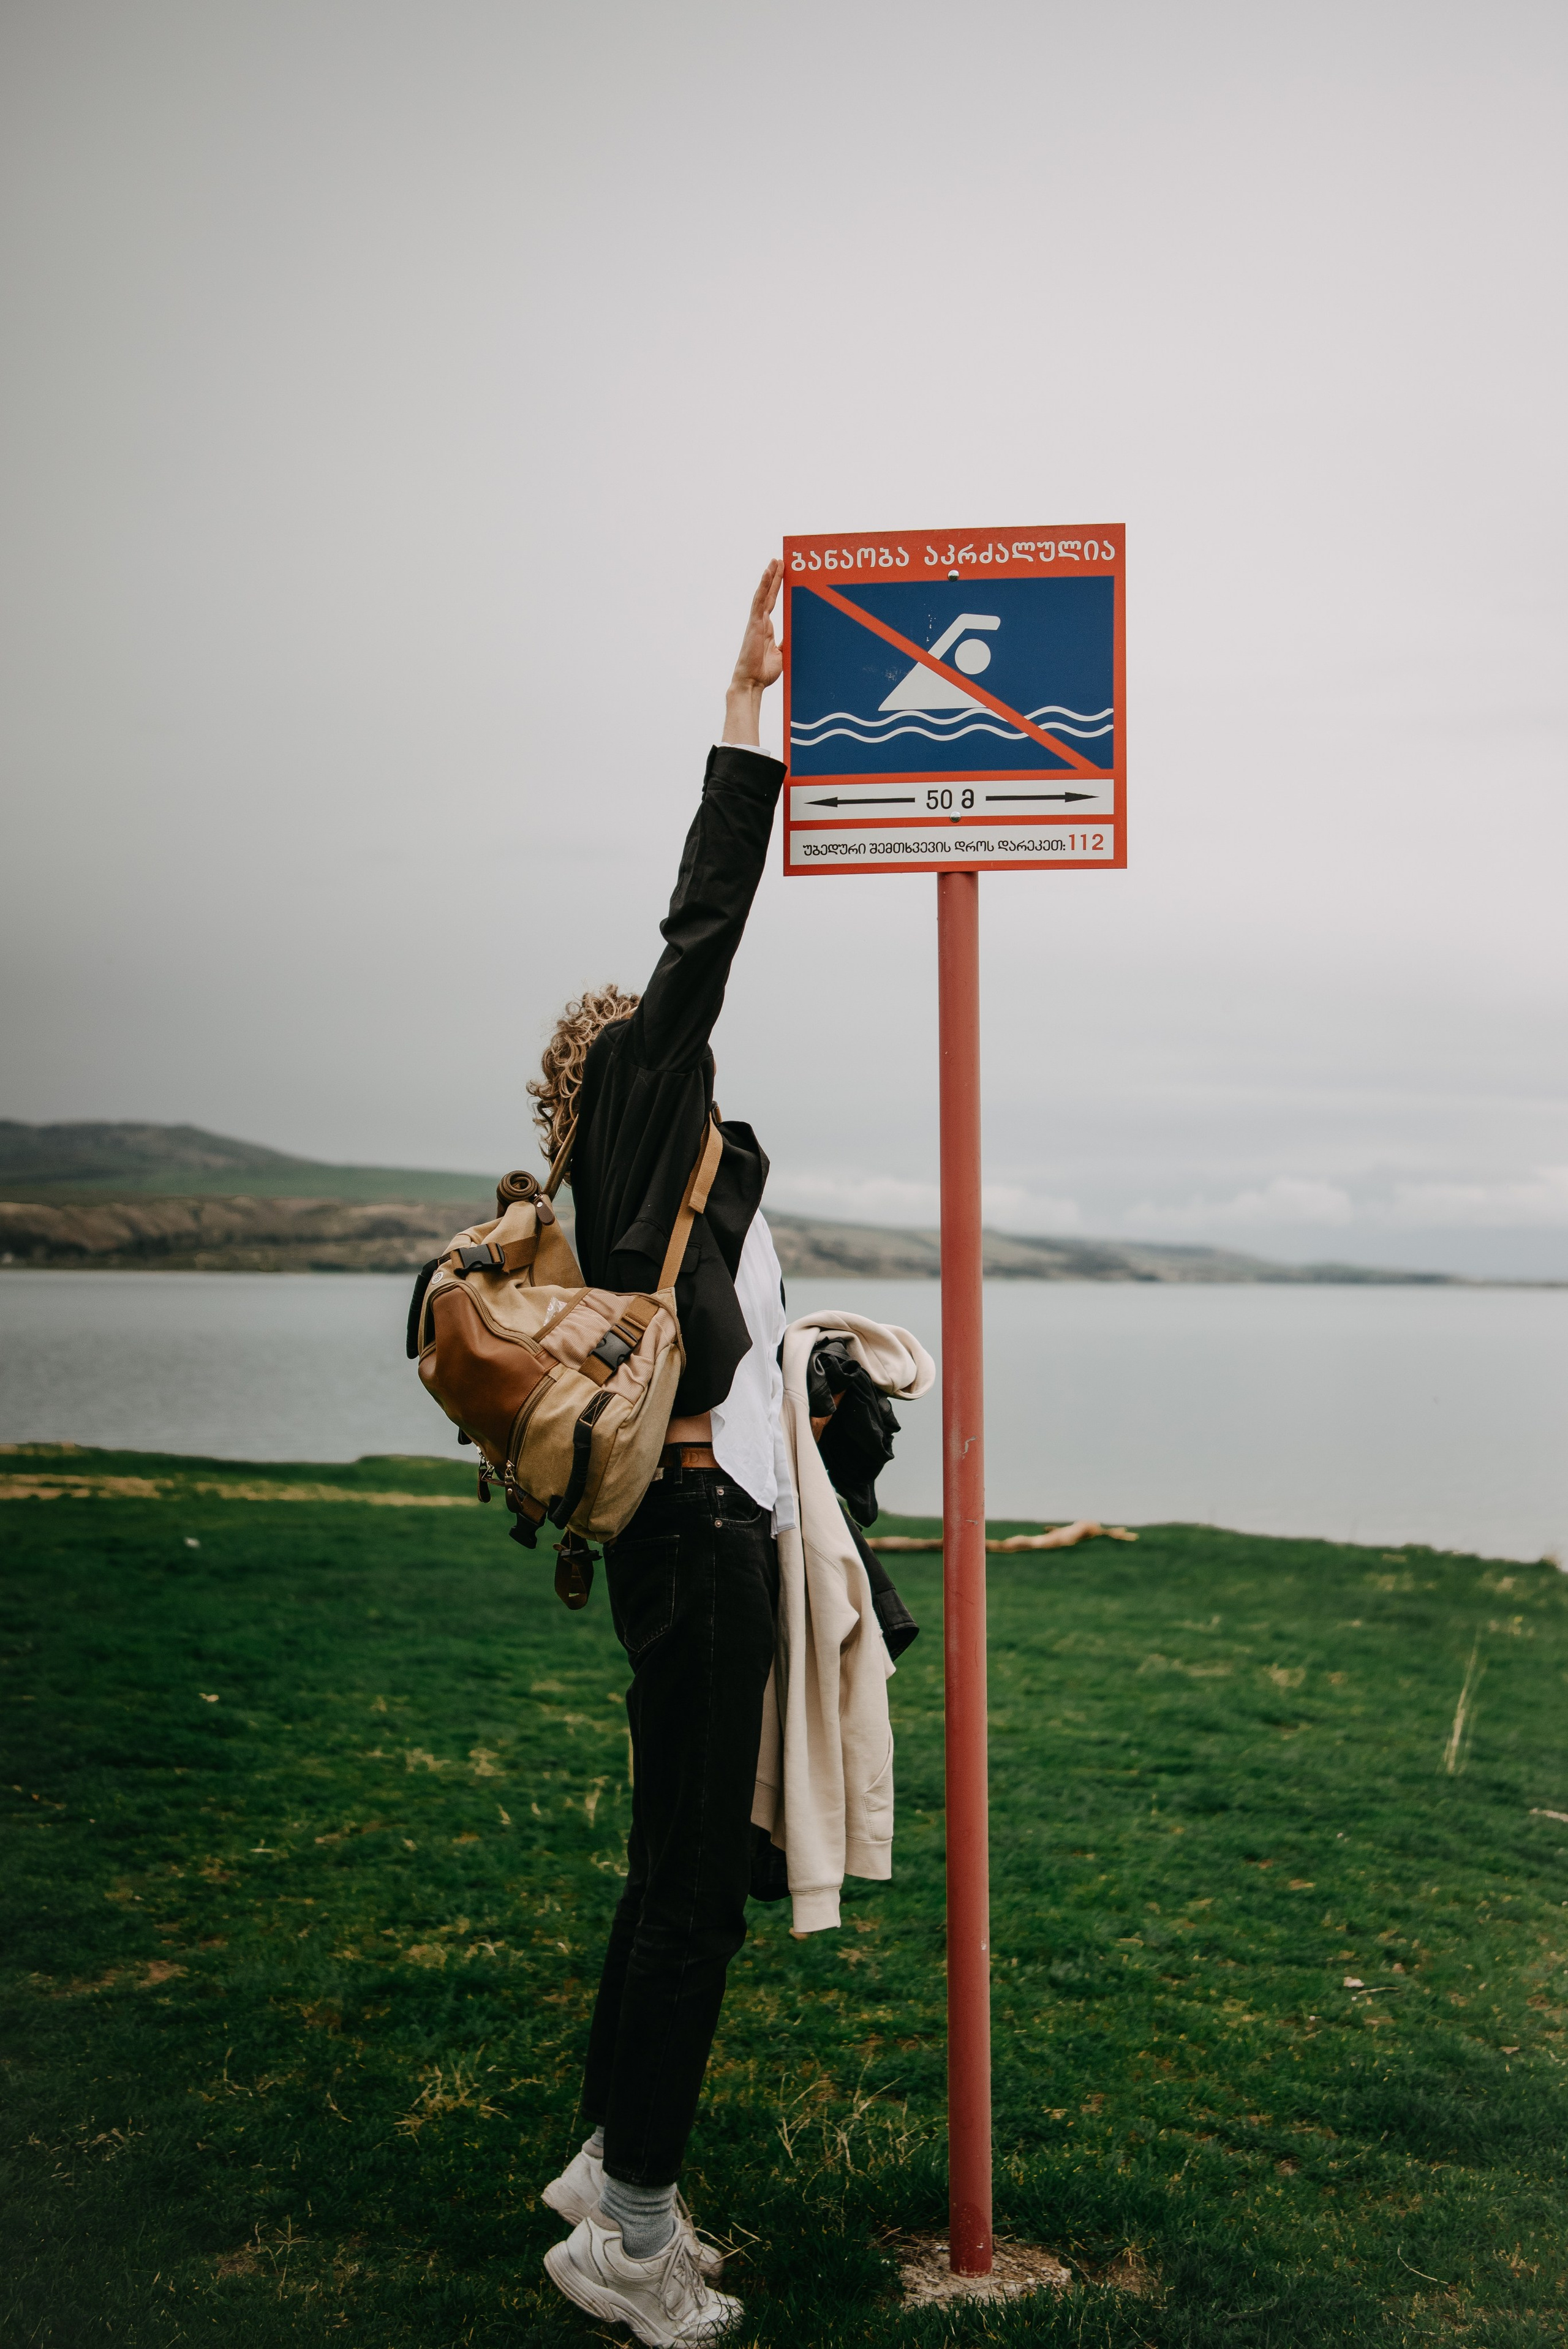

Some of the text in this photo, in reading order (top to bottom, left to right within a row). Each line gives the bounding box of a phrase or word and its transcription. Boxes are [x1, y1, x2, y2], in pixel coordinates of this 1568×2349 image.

[791, 540, 1115, 571] ბანაობა აკრძალულია
[926, 788, 974, 810] 50 მ
[802, 833, 1104, 856] უბედური შემთხვევის დროს დარეკეთ: 112
